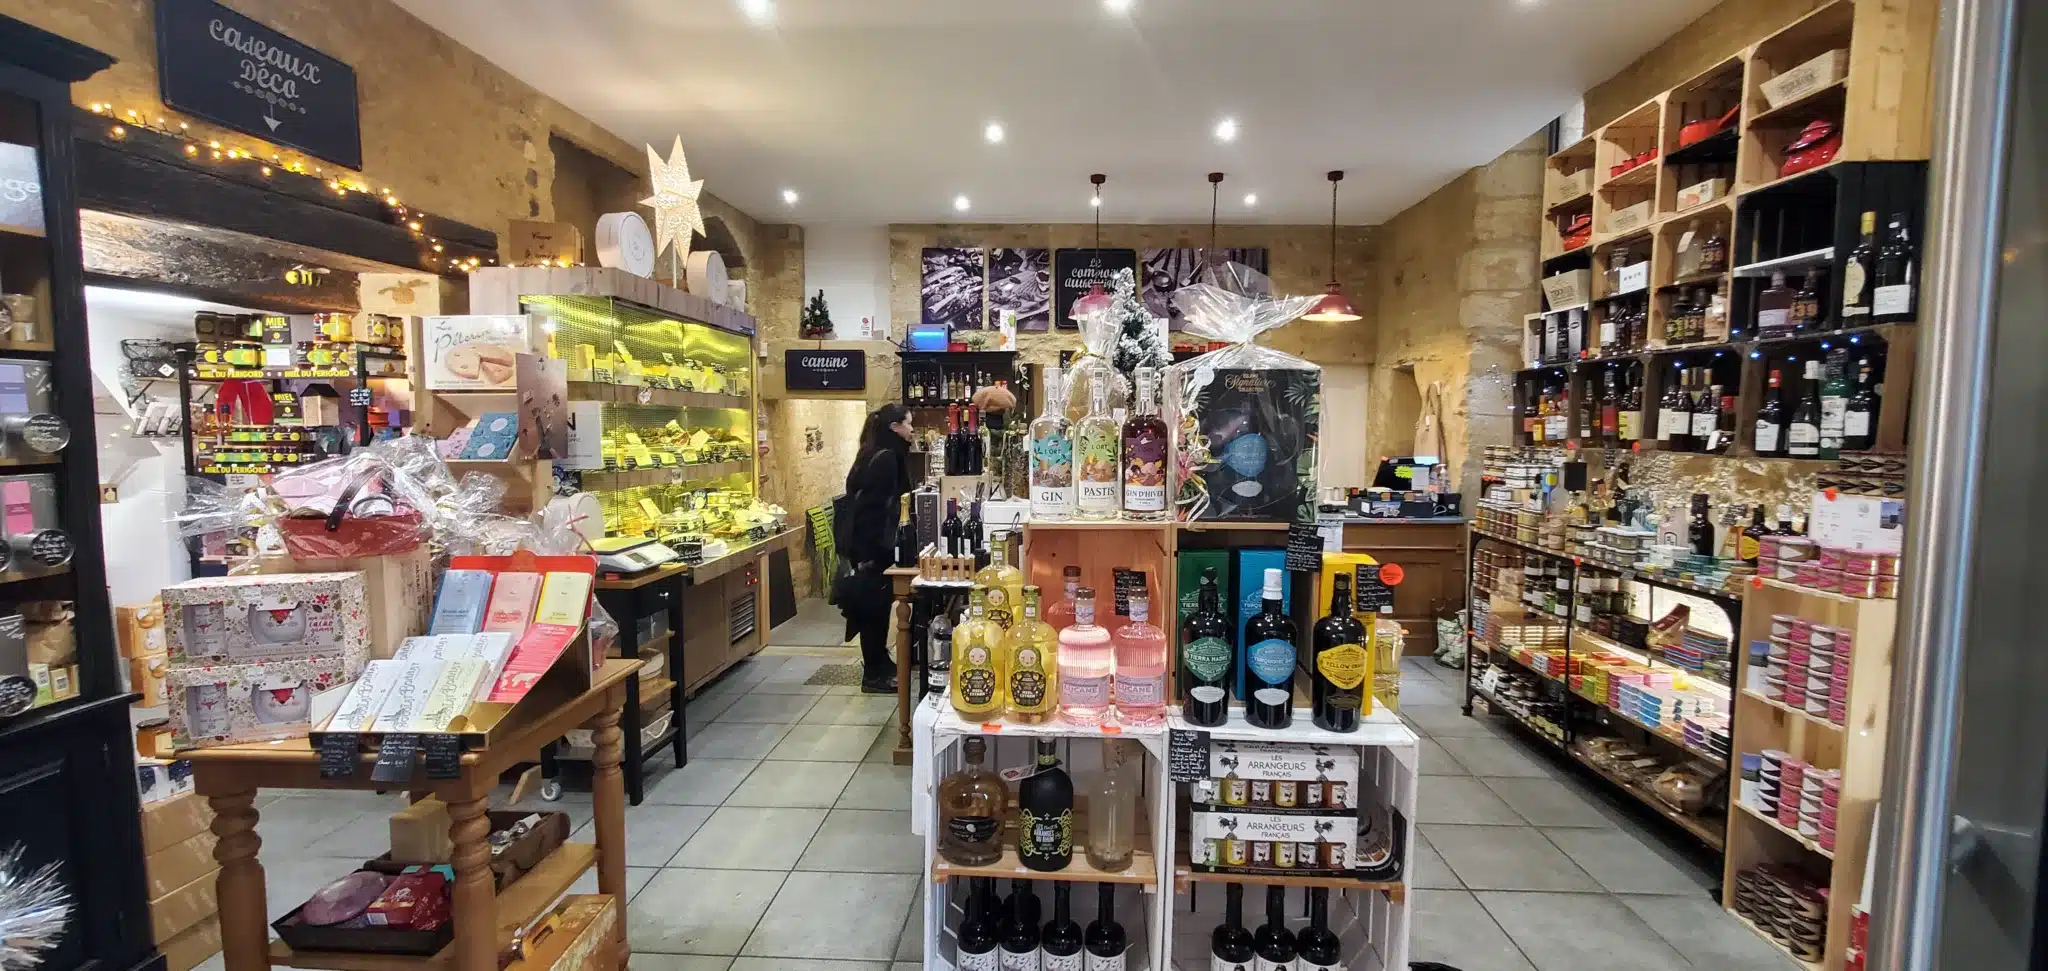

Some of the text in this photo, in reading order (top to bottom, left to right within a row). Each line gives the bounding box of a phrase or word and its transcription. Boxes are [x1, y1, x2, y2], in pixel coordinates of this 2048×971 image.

[265, 316, 288, 326] MIEL
[285, 370, 300, 378] MIEL
[302, 370, 312, 378] DU
[274, 392, 295, 401] MIEL
[204, 466, 219, 474] MIEL
[220, 466, 231, 474] DU
[1041, 491, 1064, 501] GIN
[1084, 486, 1115, 497] PASTIS
[1126, 489, 1138, 498] GIN
[309, 620, 333, 628] cacao
[1189, 653, 1210, 661] TIERRA
[1326, 661, 1350, 669] YELLOW
[1063, 685, 1098, 694] LUCANE
[1117, 684, 1152, 694] LUCANE
[1247, 761, 1307, 771] ARRANGEURS
[1246, 822, 1305, 832] ARRANGEURS
